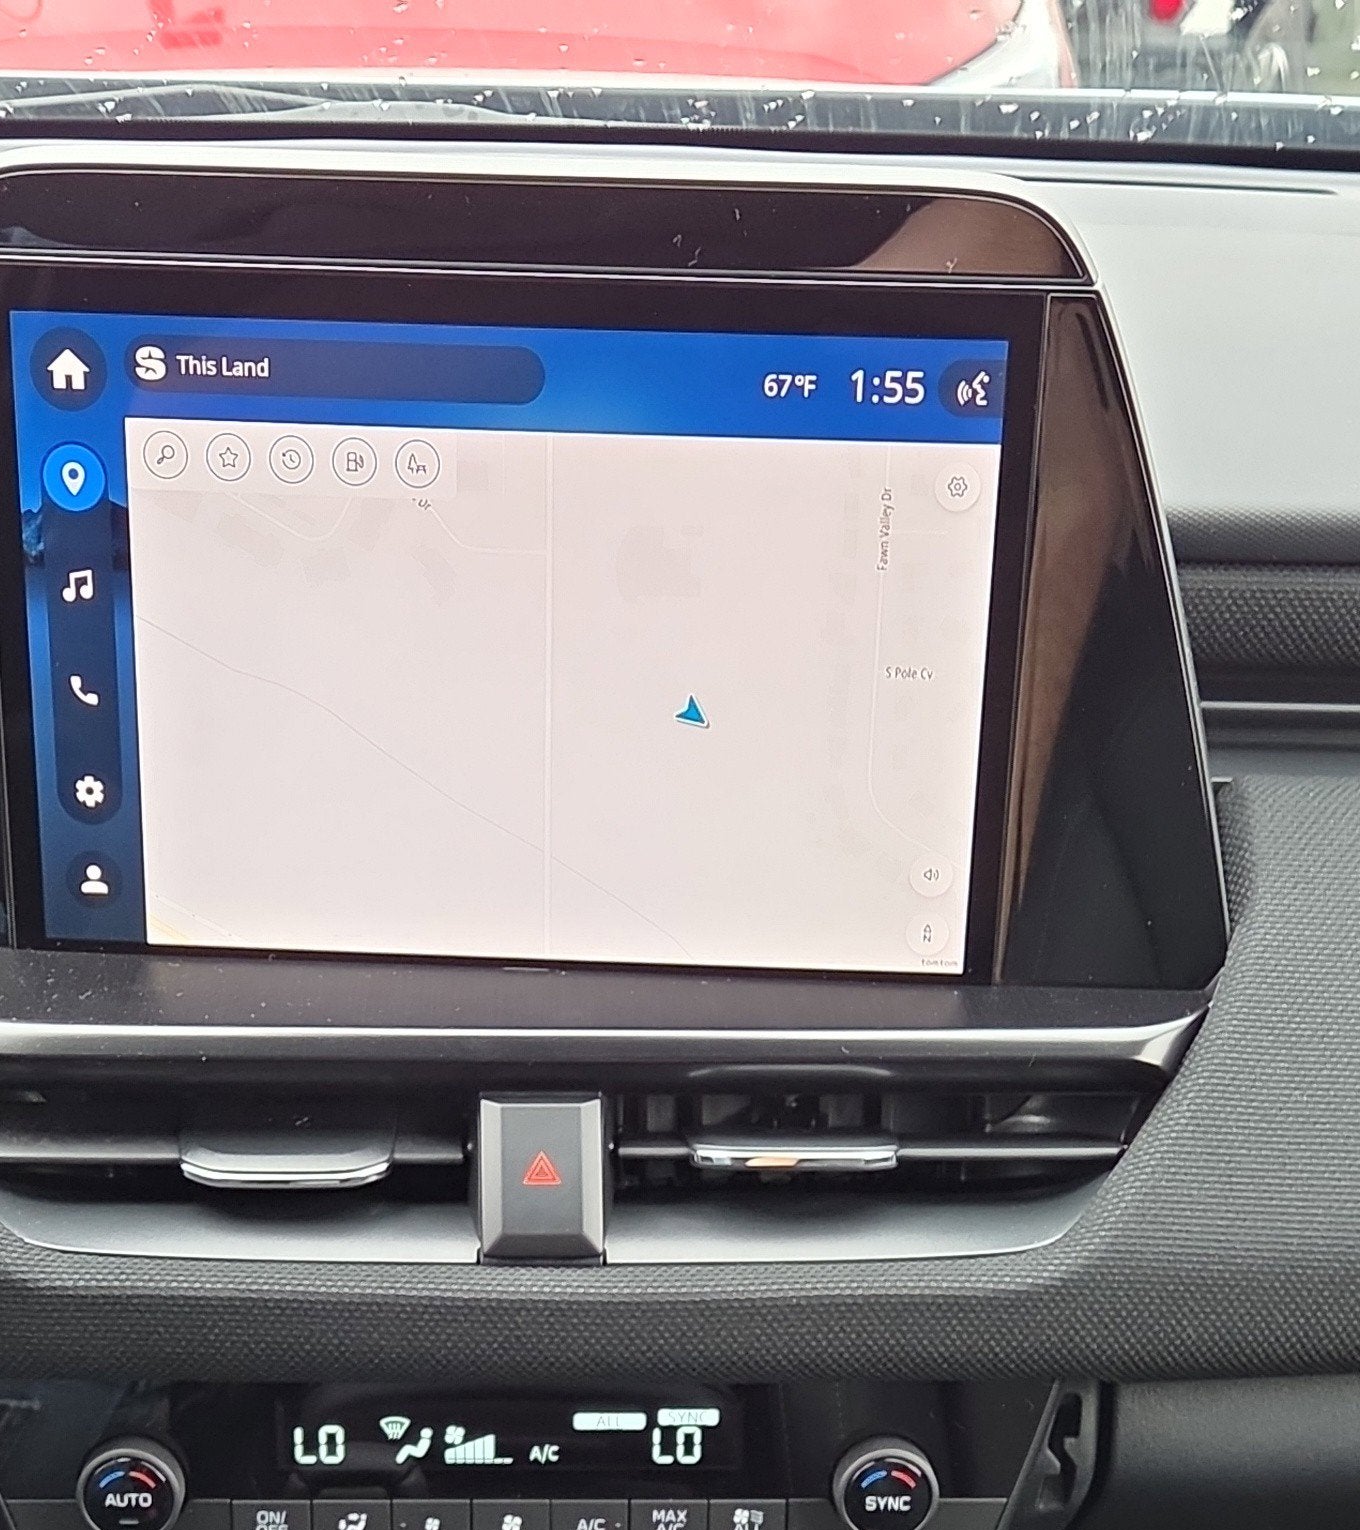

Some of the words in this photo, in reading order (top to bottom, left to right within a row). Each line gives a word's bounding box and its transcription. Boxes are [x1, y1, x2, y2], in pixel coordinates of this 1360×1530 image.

[175, 355, 217, 375] This
[221, 357, 270, 378] Land
[763, 373, 818, 399] 67°F
[850, 369, 926, 404] 1:55
[879, 503, 893, 541] Valley
[529, 1444, 560, 1464] A/C
[104, 1492, 153, 1508] AUTO
[864, 1495, 912, 1513] SYNC
[256, 1510, 287, 1525] ON/
[652, 1509, 688, 1523] MAX
